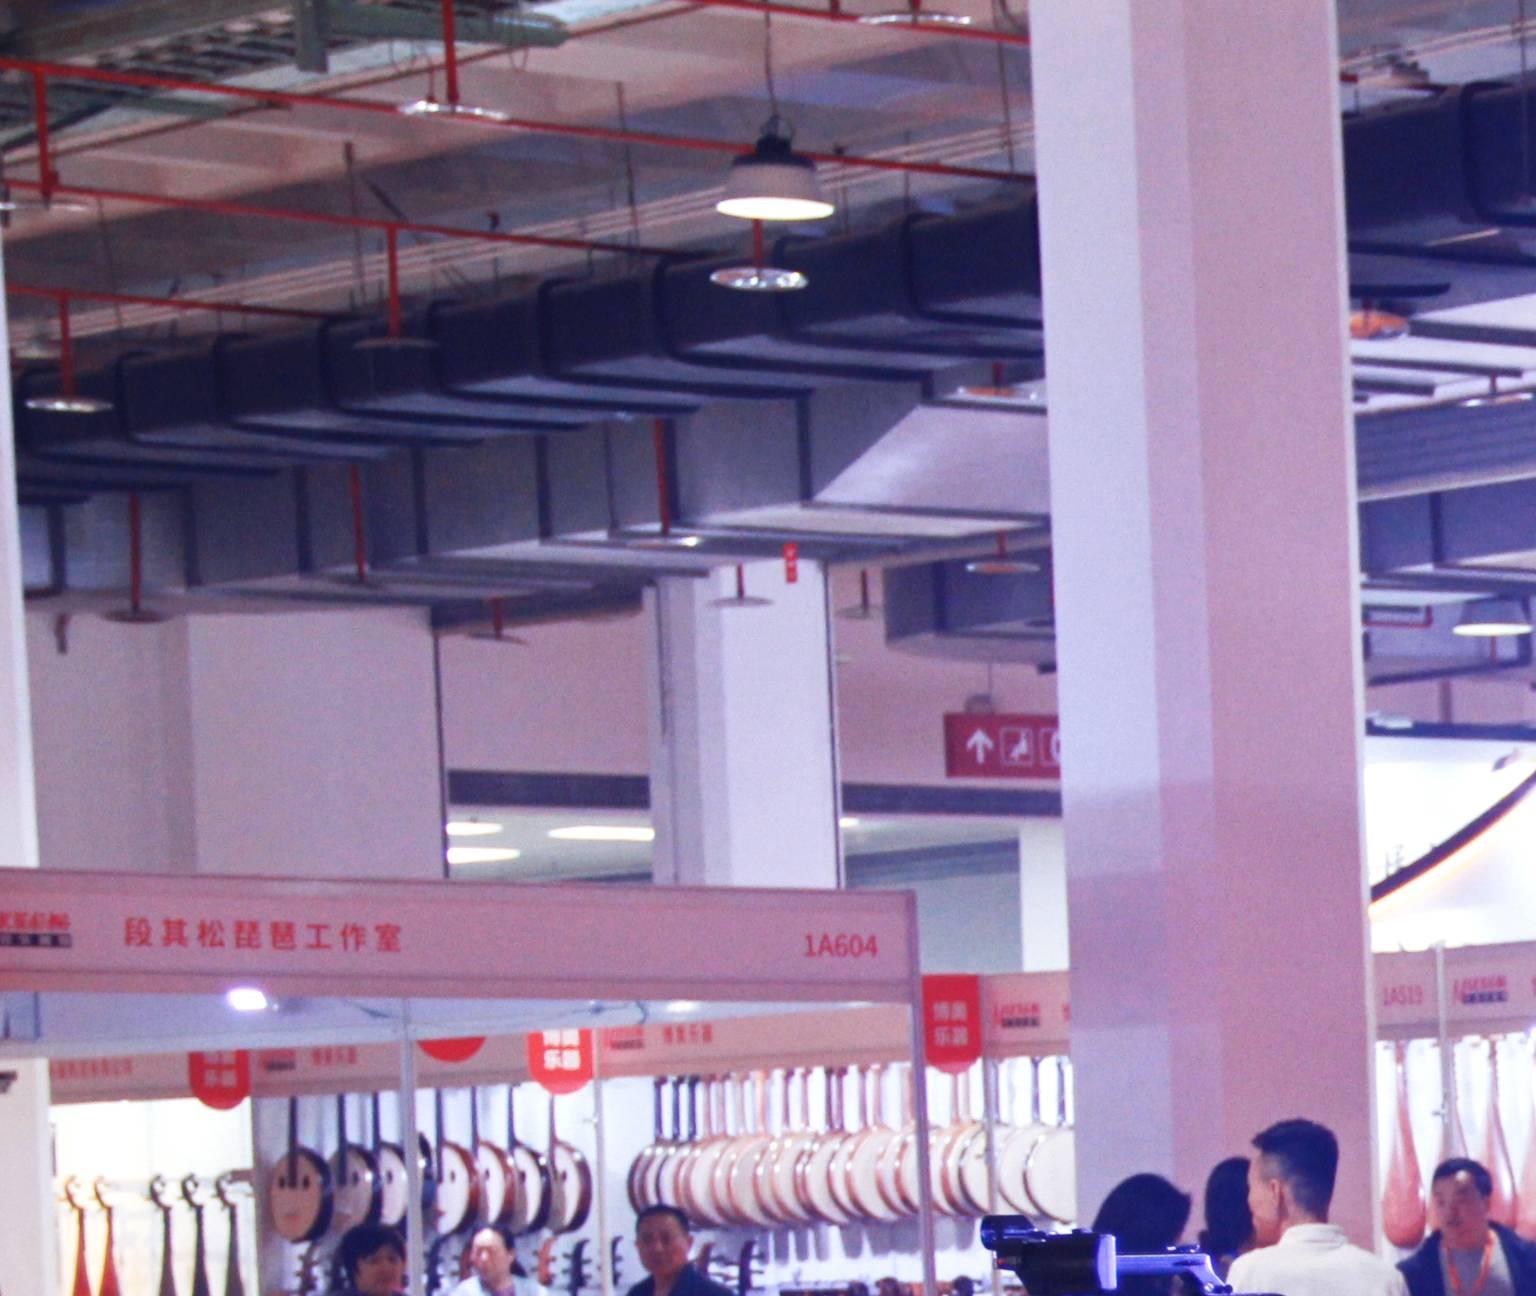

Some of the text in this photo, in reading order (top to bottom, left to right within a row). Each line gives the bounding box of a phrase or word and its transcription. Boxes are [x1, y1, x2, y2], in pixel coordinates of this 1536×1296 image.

[123, 917, 401, 953] 段其松琵琶工作室
[804, 933, 878, 958] 1A604
